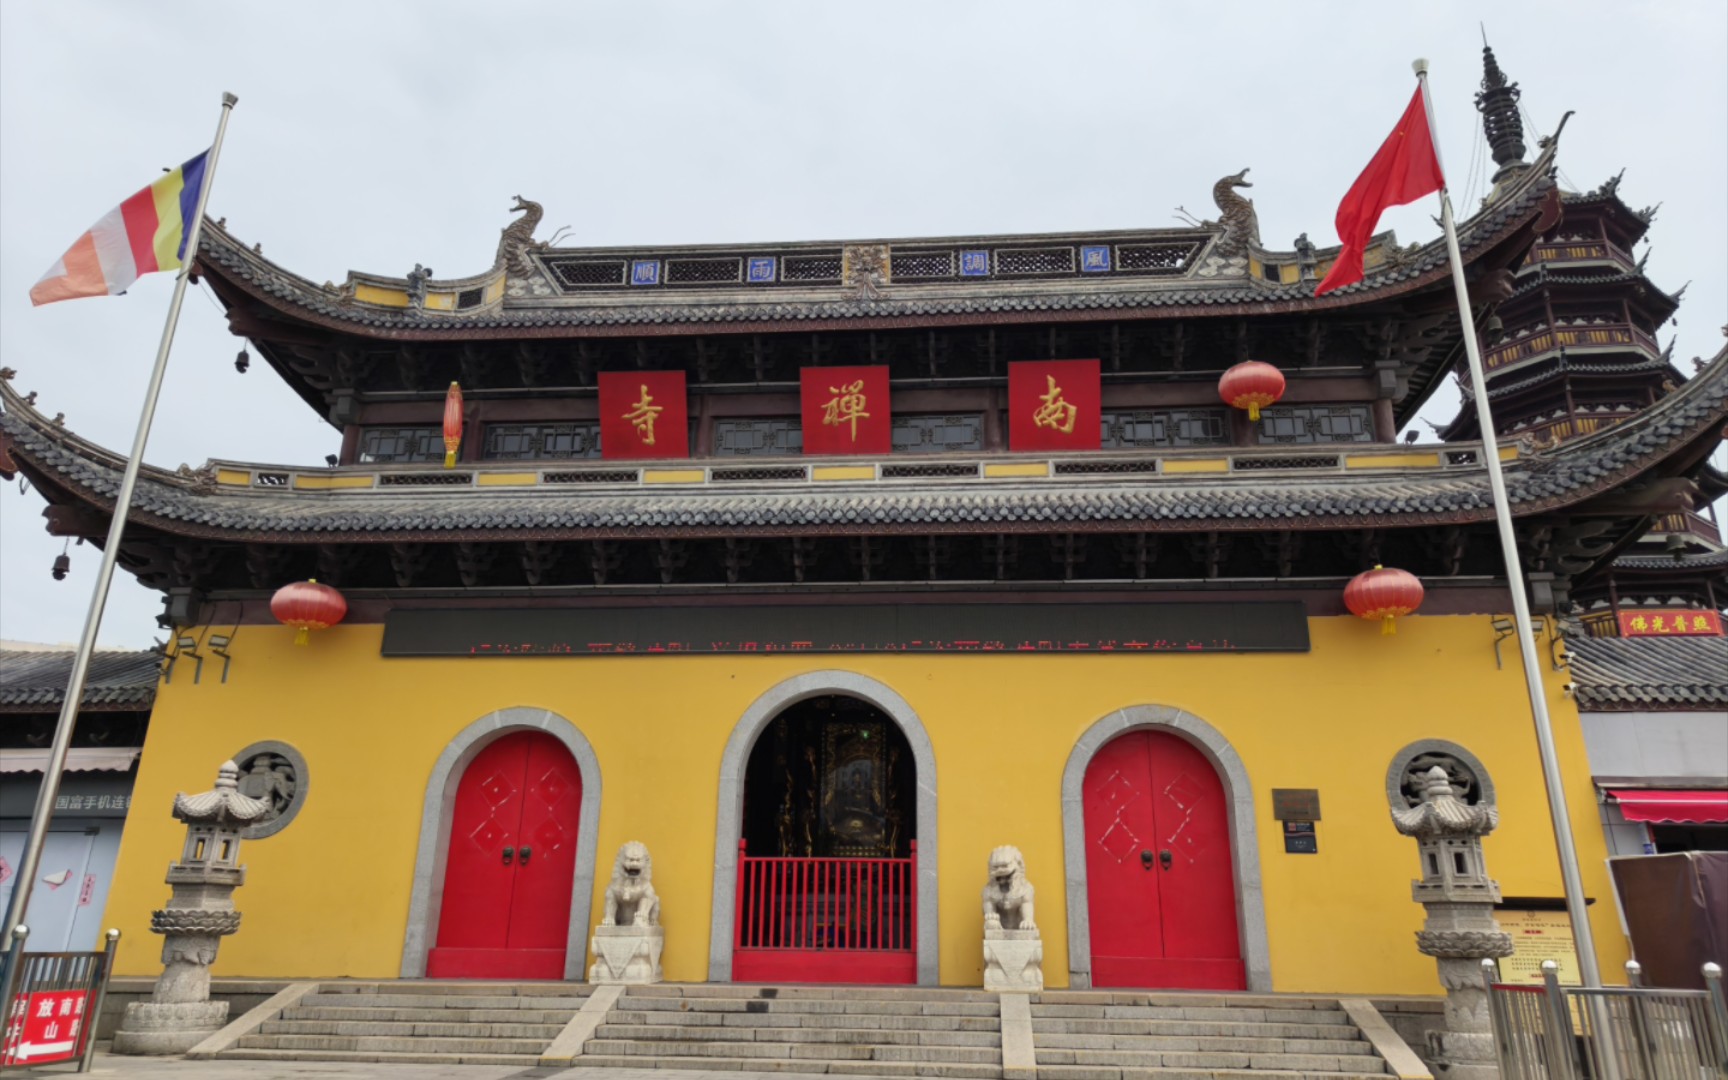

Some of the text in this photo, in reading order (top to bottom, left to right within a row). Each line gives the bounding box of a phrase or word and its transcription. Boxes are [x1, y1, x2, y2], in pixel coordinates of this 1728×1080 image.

[635, 263, 655, 281] 順
[752, 260, 771, 278] 雨
[1033, 374, 1078, 434] 南
[621, 384, 664, 445] 寺
[1630, 614, 1712, 633] 佛光普照
